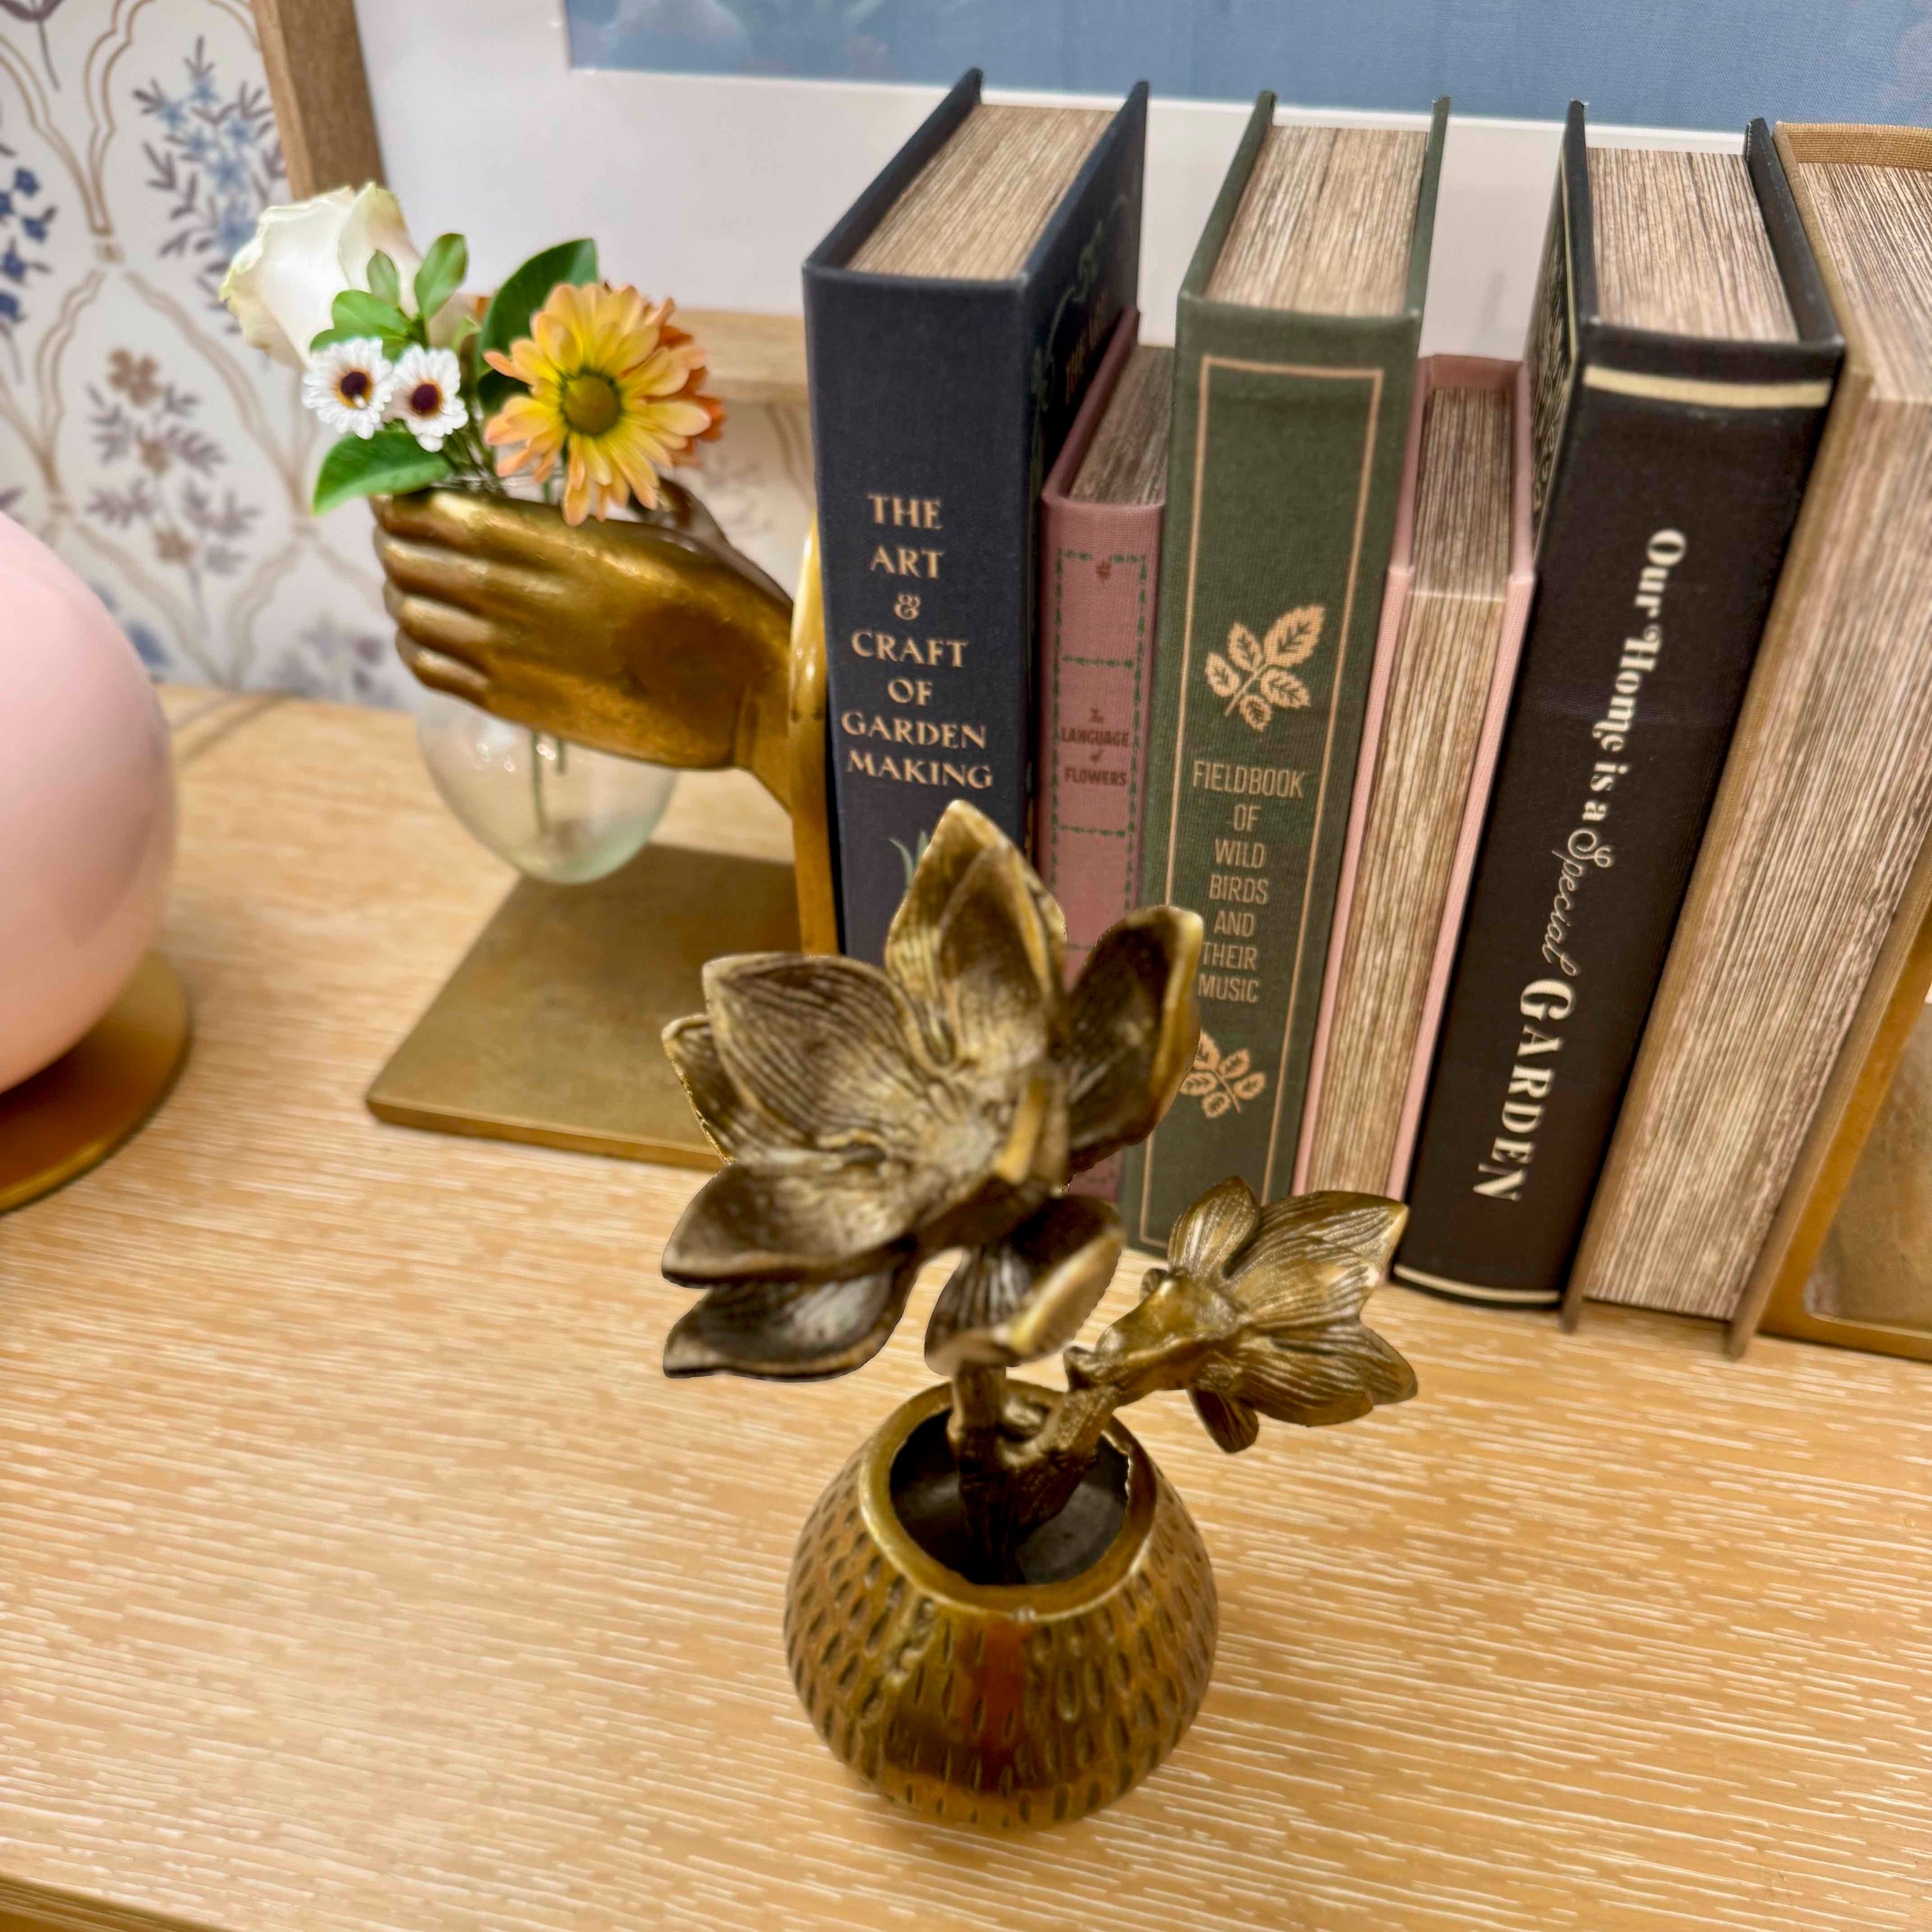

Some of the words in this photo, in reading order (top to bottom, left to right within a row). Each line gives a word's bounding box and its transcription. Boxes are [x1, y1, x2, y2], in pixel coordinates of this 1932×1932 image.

[867, 492, 943, 530] THE
[870, 544, 943, 579] ART
[1635, 528, 1687, 618] Our
[893, 593, 920, 620] &
[851, 630, 968, 668] CRAFT
[888, 679, 933, 706] OF
[1592, 624, 1661, 752] Home
[841, 710, 987, 749] GARDEN
[1061, 727, 1129, 747] LANGUAGE
[847, 749, 993, 789] MAKING
[1065, 767, 1127, 787] FLOWERS
[1193, 760, 1306, 798] FIELDBOOK
[1590, 761, 1629, 792] is
[1233, 804, 1261, 832] OF
[1582, 800, 1607, 822] a
[1214, 838, 1266, 869] WILD
[1209, 874, 1269, 905] BIRDS
[1541, 828, 1615, 977] Special
[1214, 911, 1255, 938] AND
[1202, 942, 1258, 971] THEIR
[1198, 974, 1259, 1003] MUSIC
[1473, 978, 1576, 1201] GARDEN
